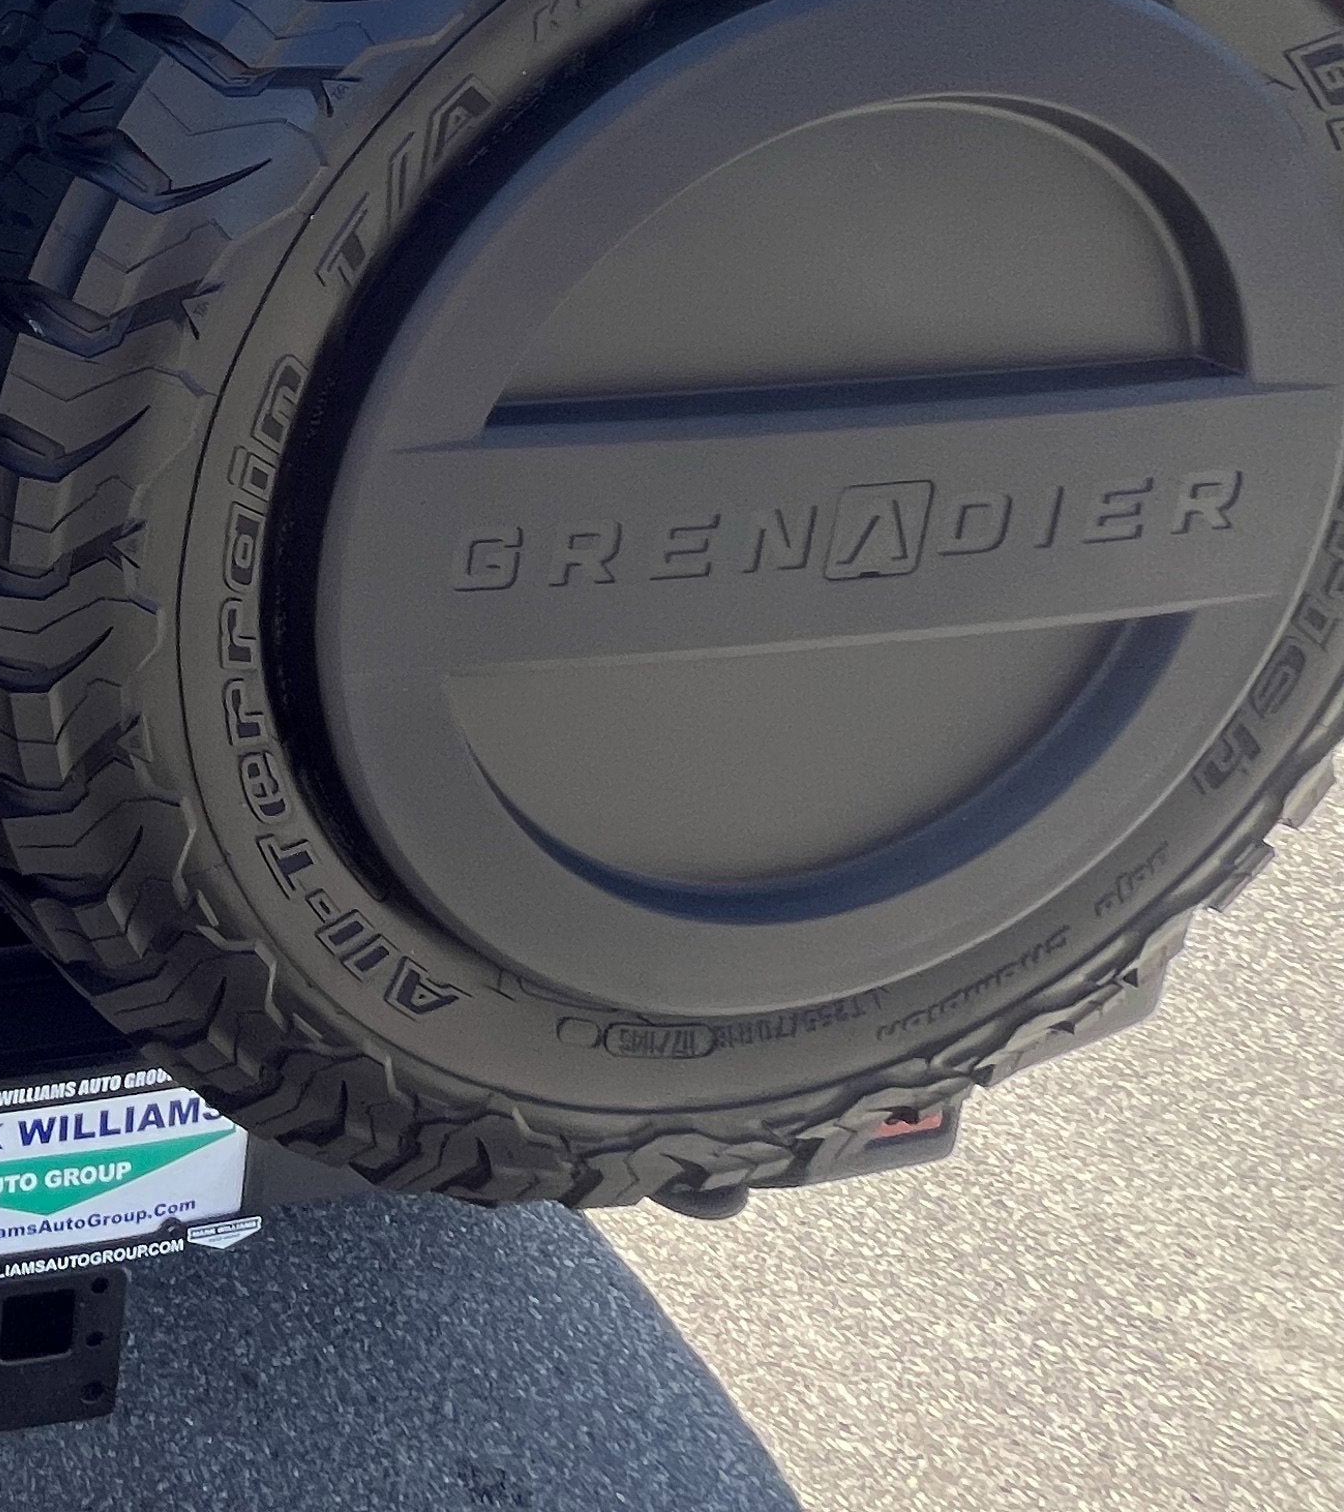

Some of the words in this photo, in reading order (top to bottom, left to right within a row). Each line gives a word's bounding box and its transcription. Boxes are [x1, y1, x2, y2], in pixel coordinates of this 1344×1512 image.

[454, 469, 1244, 592] GRENADIER
[78, 1074, 122, 1098] AUTO
[124, 1068, 173, 1089] GROU
[44, 1161, 132, 1189] GROUP
